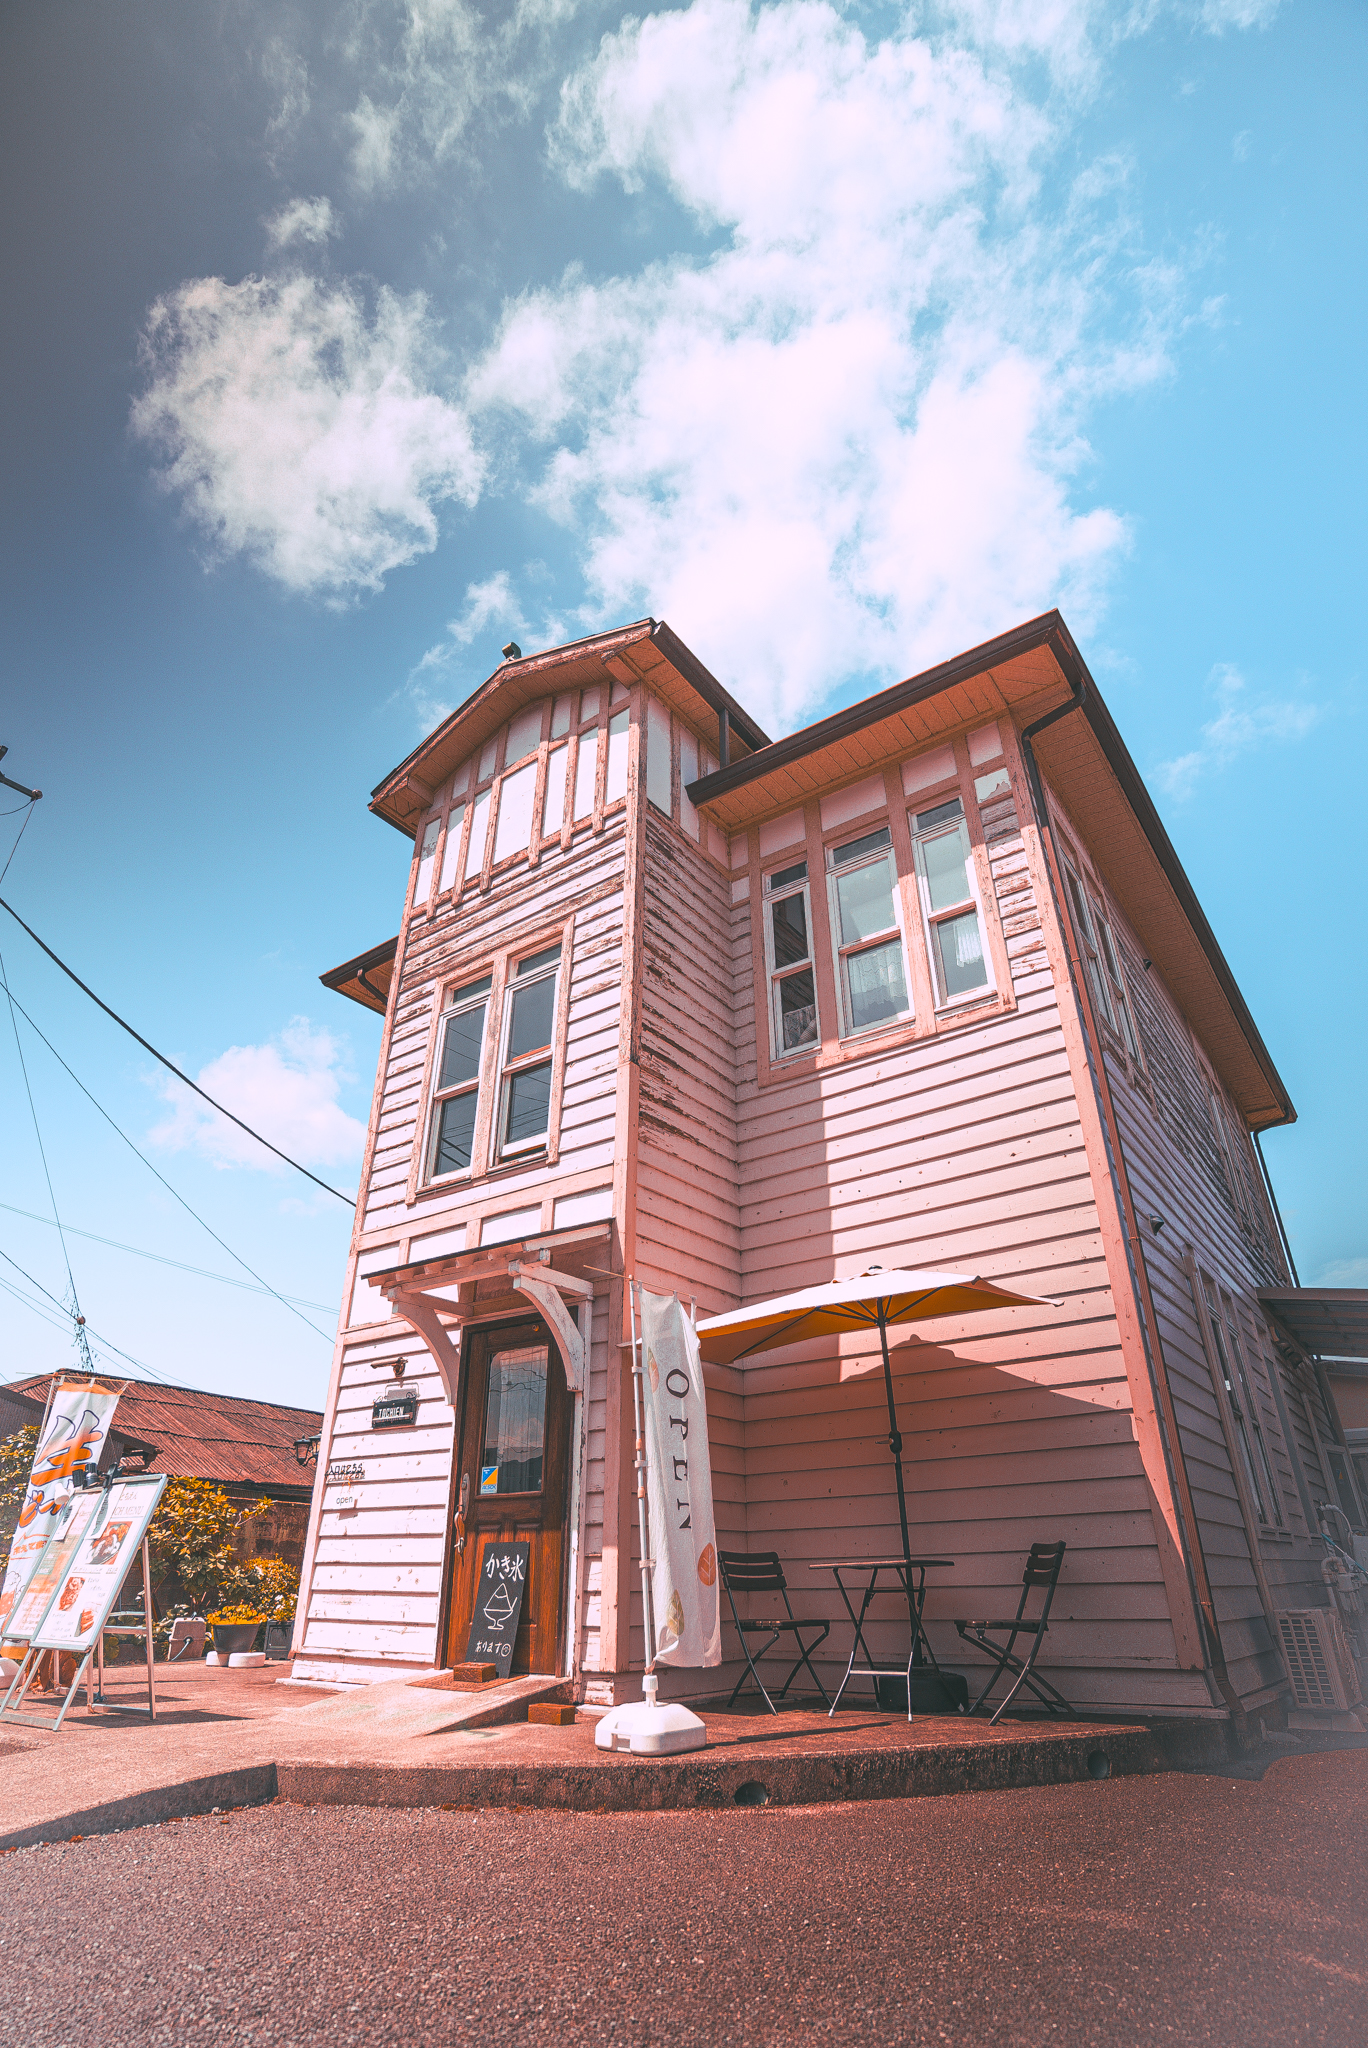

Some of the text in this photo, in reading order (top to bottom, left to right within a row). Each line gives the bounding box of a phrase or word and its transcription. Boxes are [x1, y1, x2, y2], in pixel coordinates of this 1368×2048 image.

[30, 1410, 103, 1487] 生
[665, 1368, 692, 1529] OPEN
[336, 1496, 353, 1506] open
[485, 1553, 525, 1582] かき氷
[474, 1640, 503, 1654] あります
